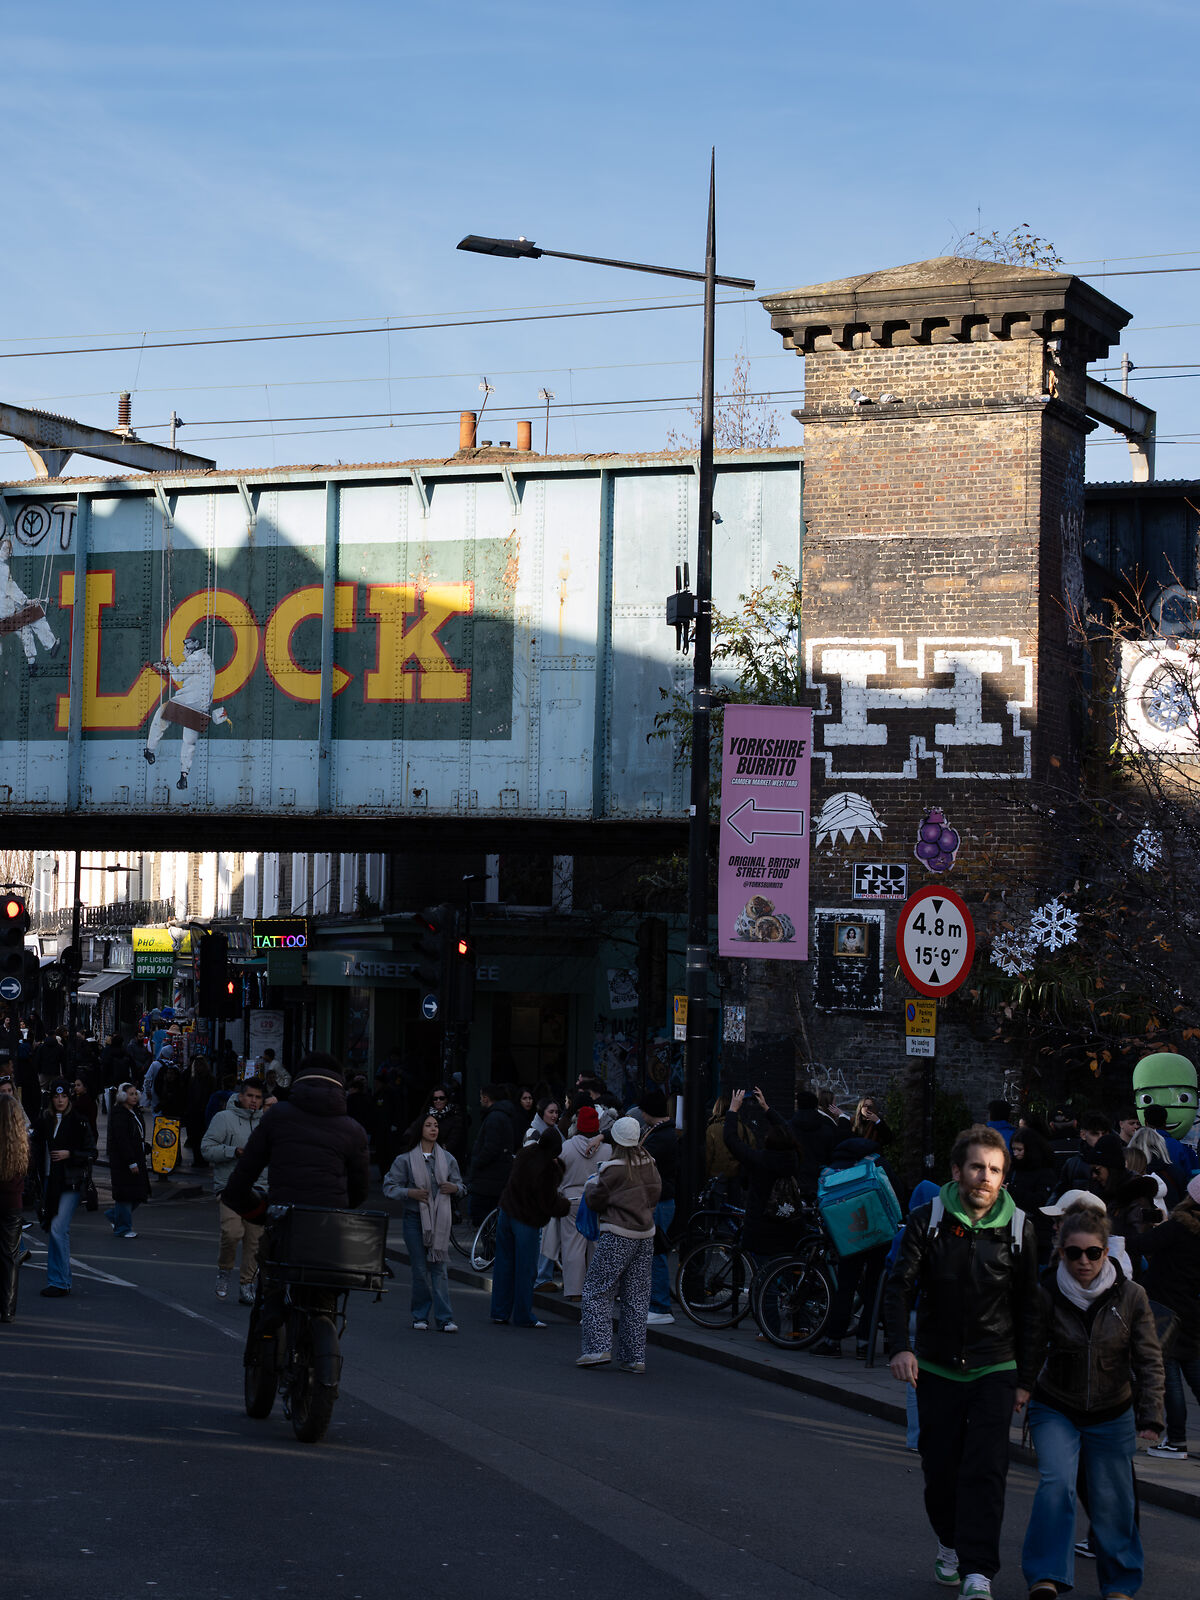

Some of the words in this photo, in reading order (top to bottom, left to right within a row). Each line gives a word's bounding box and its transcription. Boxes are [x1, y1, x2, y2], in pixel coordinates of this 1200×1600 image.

[55, 569, 475, 731] LOCK
[729, 737, 806, 758] YORKSHIRE
[736, 756, 797, 776] BURRITO
[731, 777, 751, 785] CAMDEN
[751, 778, 771, 786] MARKET
[728, 855, 766, 867] ORIGINAL
[767, 857, 801, 869] BRITISH
[736, 866, 767, 878] STREET
[767, 868, 790, 879] FOOD
[855, 864, 905, 880] END
[743, 881, 784, 889] @YORKSBURRITO
[855, 879, 905, 894] LESS
[912, 912, 944, 936] 4.8
[948, 924, 962, 938] m
[253, 934, 306, 947] TATTOO
[149, 956, 174, 964] LICENCE
[137, 965, 155, 974] OPEN
[156, 965, 173, 974] 24/7
